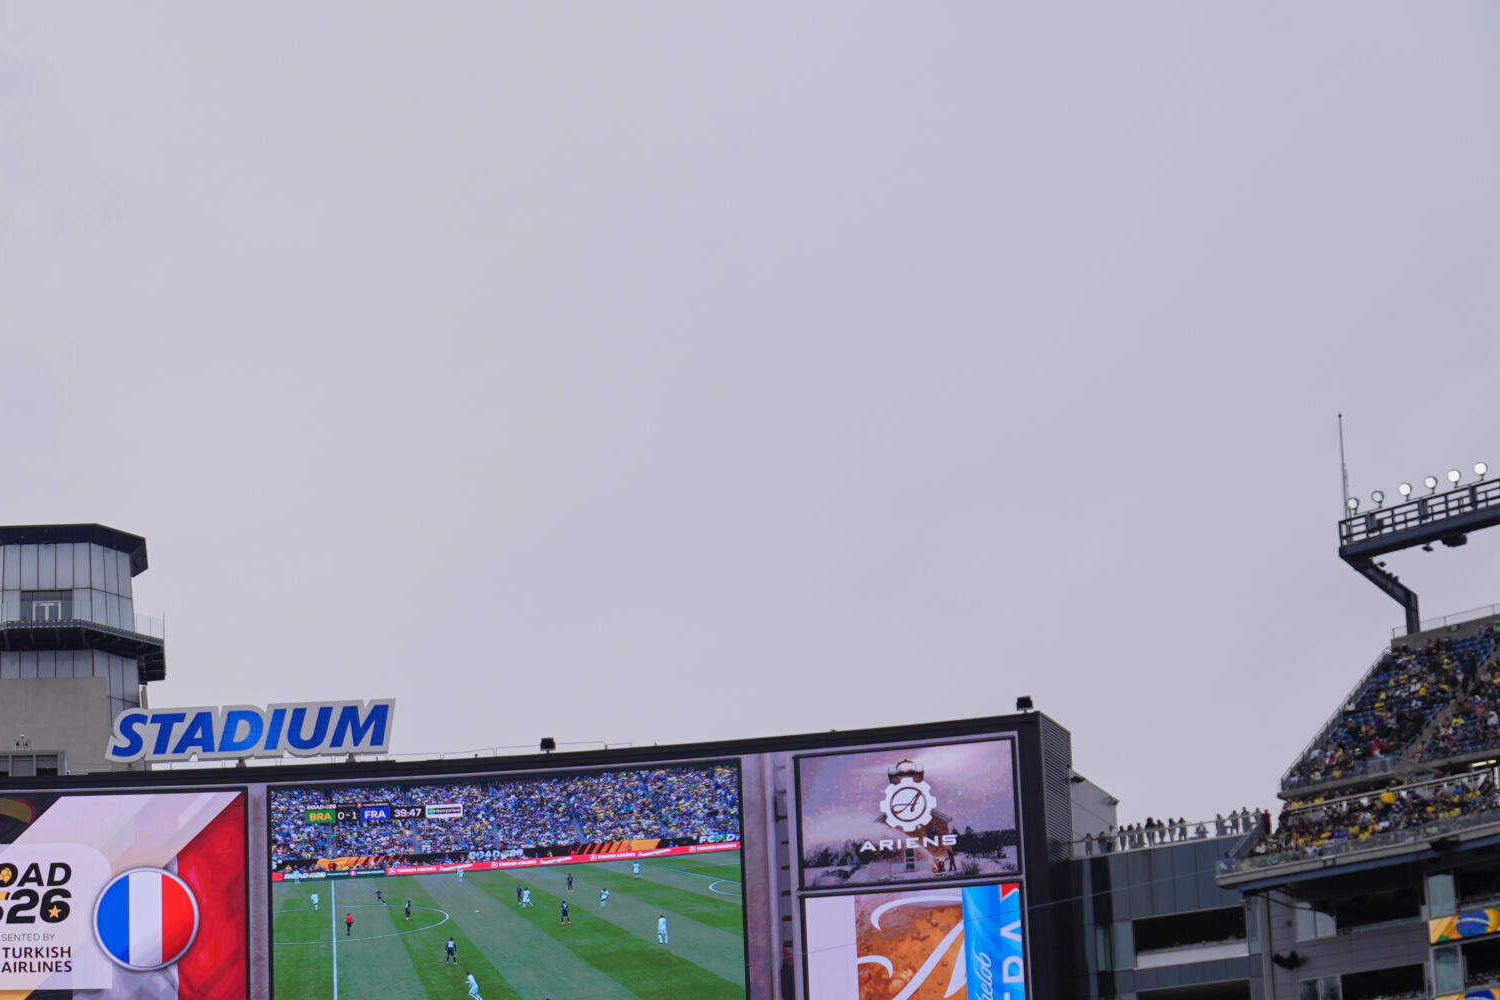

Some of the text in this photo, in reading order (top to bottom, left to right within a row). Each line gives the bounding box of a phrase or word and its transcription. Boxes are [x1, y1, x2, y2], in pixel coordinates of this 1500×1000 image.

[113, 703, 390, 757] STADIUM
[309, 812, 332, 821] BRA
[364, 809, 387, 818] FRA
[394, 808, 422, 817] 39:47
[860, 834, 958, 853] ARIENS
[43, 932, 56, 941] BY
[2, 946, 71, 959] TURKISH
[1, 960, 72, 974] AIRLINES
